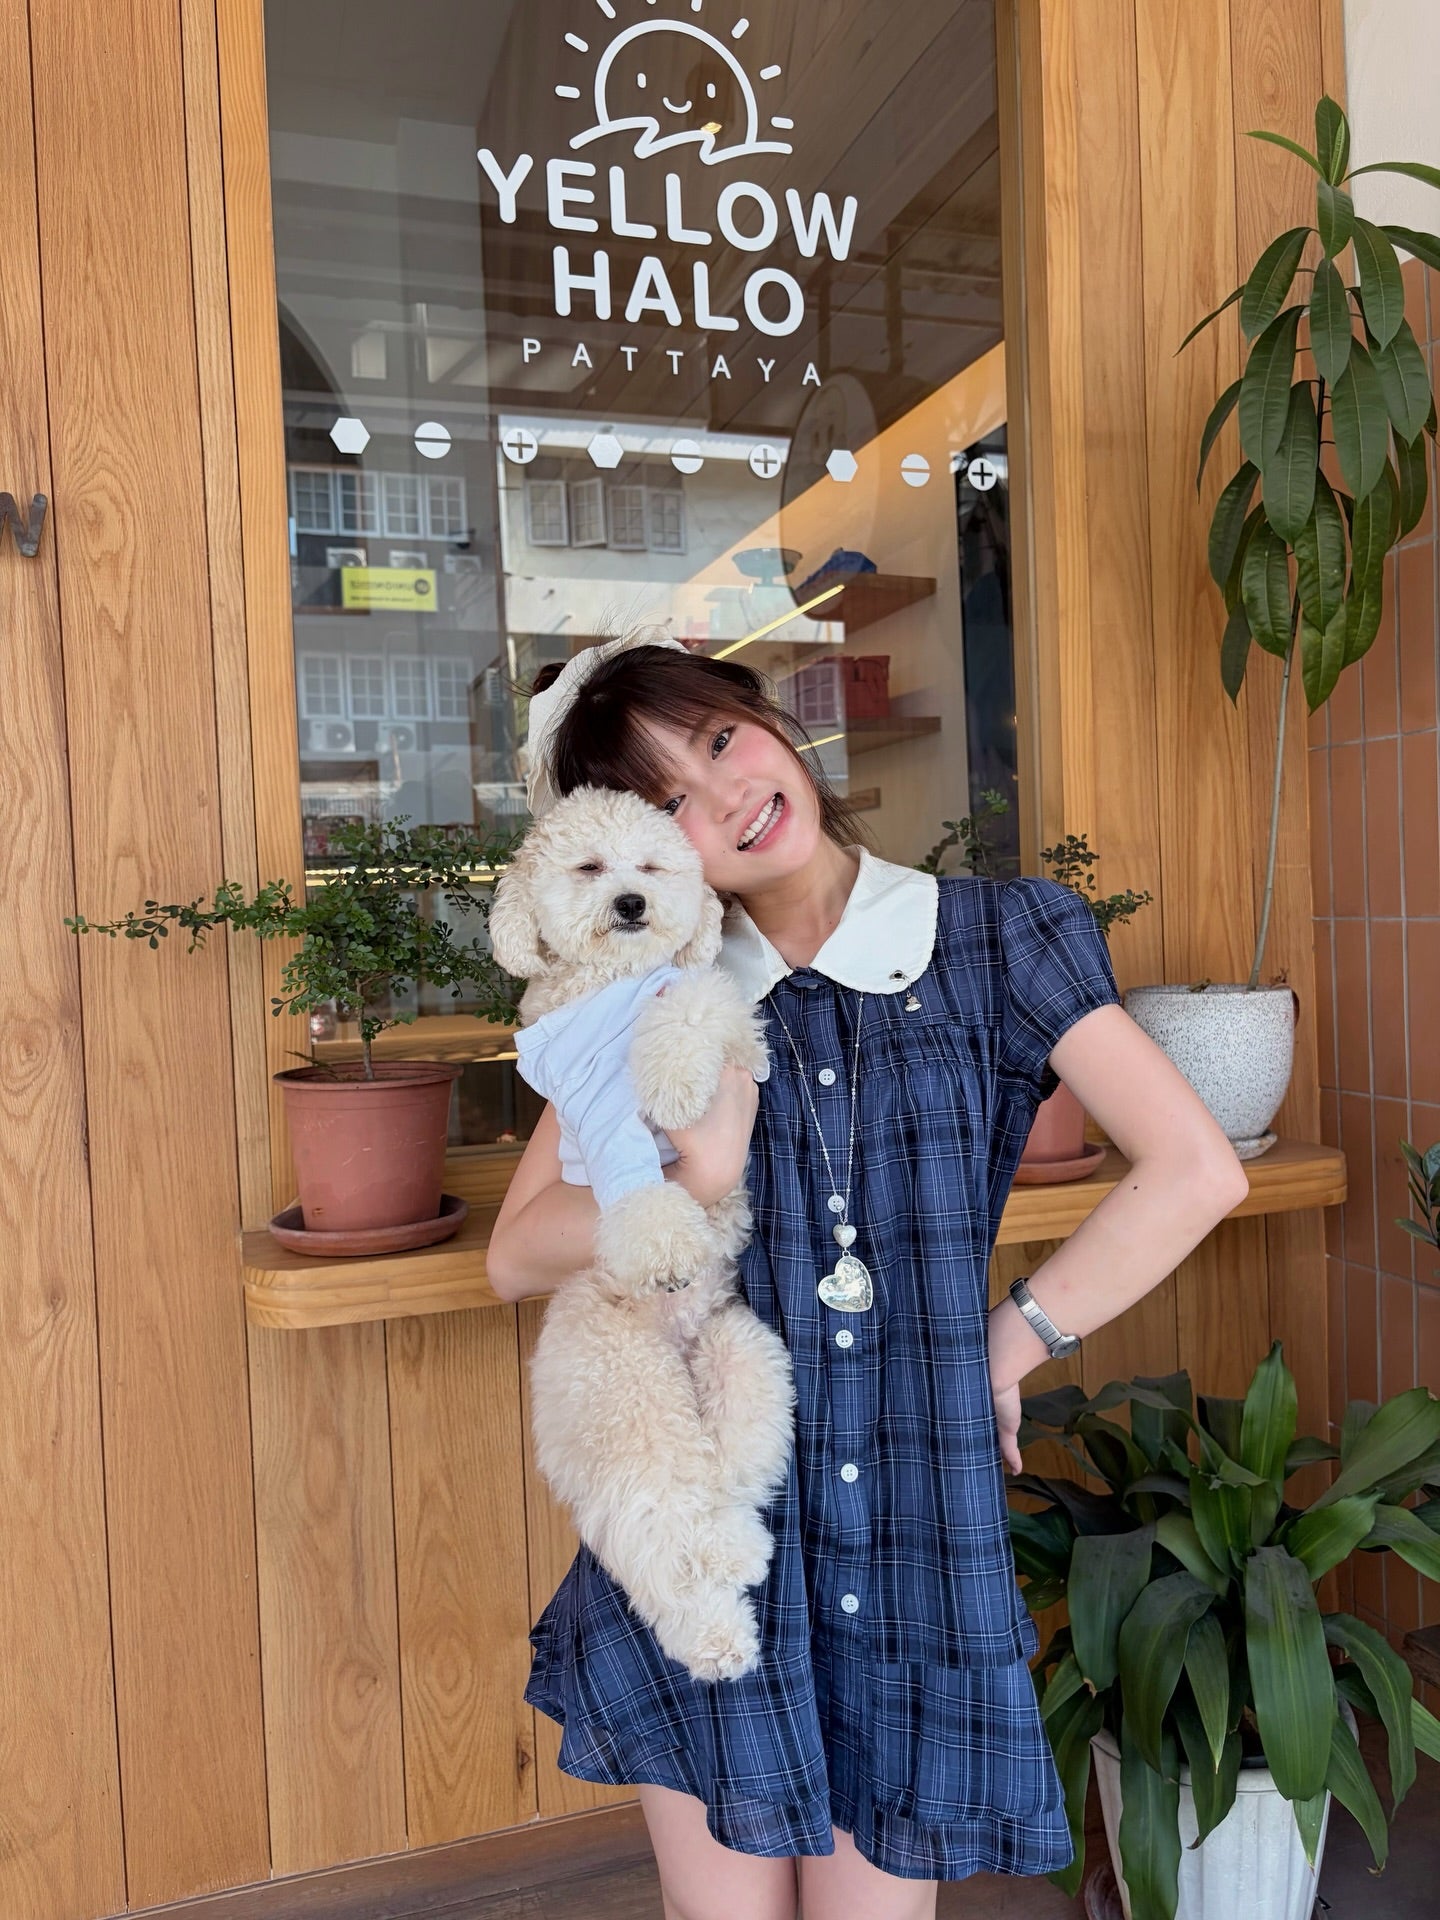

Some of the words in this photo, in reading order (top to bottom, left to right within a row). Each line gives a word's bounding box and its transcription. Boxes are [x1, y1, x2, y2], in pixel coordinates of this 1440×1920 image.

[476, 148, 859, 262] YELLOW
[552, 245, 806, 338] HALO
[522, 337, 823, 388] PATTAYA
